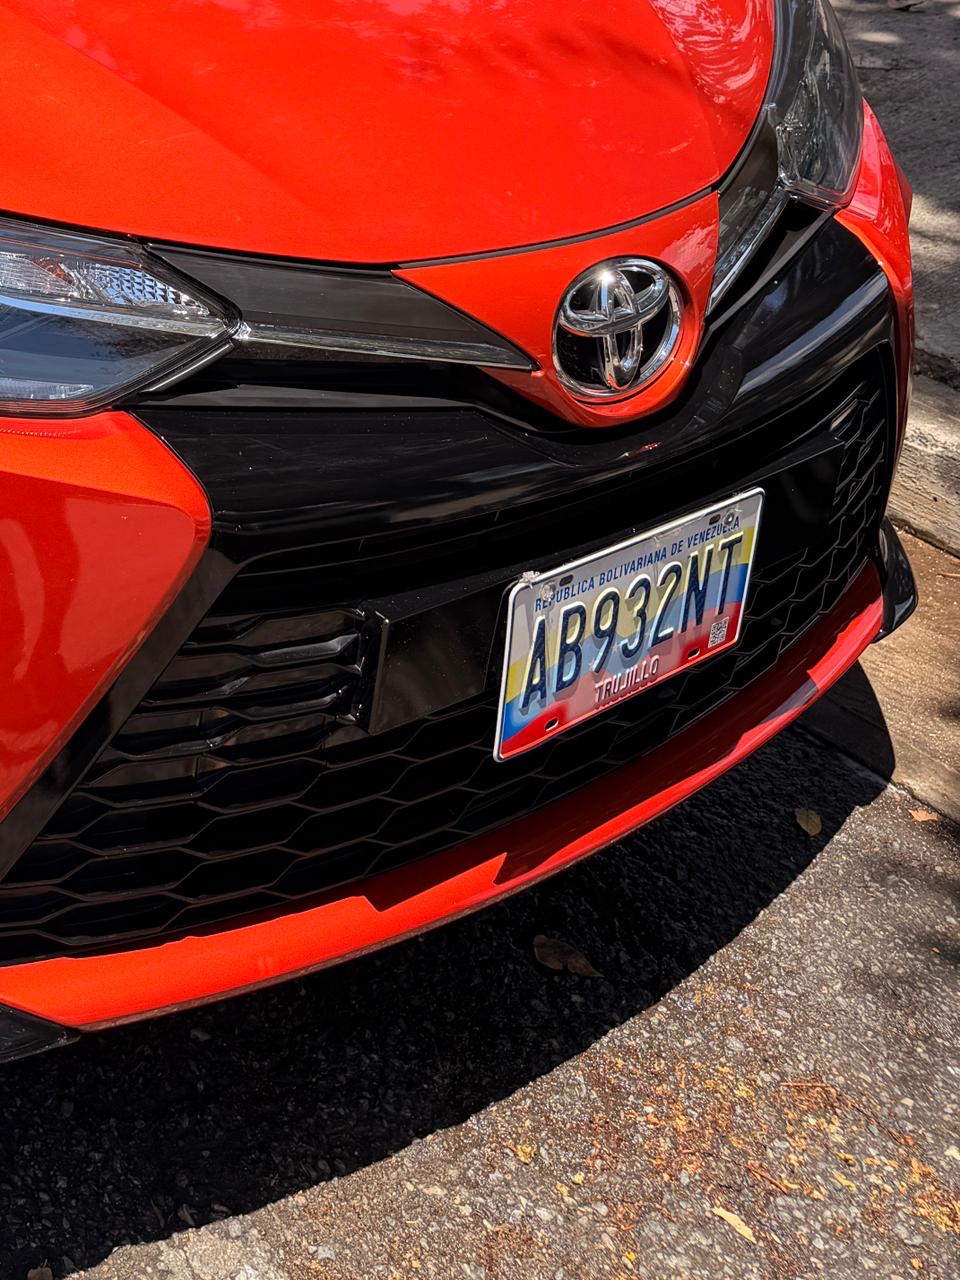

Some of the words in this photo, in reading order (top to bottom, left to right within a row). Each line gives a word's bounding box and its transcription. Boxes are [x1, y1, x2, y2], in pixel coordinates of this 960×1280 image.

[599, 546, 667, 586] BOLIVARIANA
[671, 540, 684, 556] DE
[520, 531, 744, 710] AB932NT
[595, 655, 659, 703] TRUJILLO
